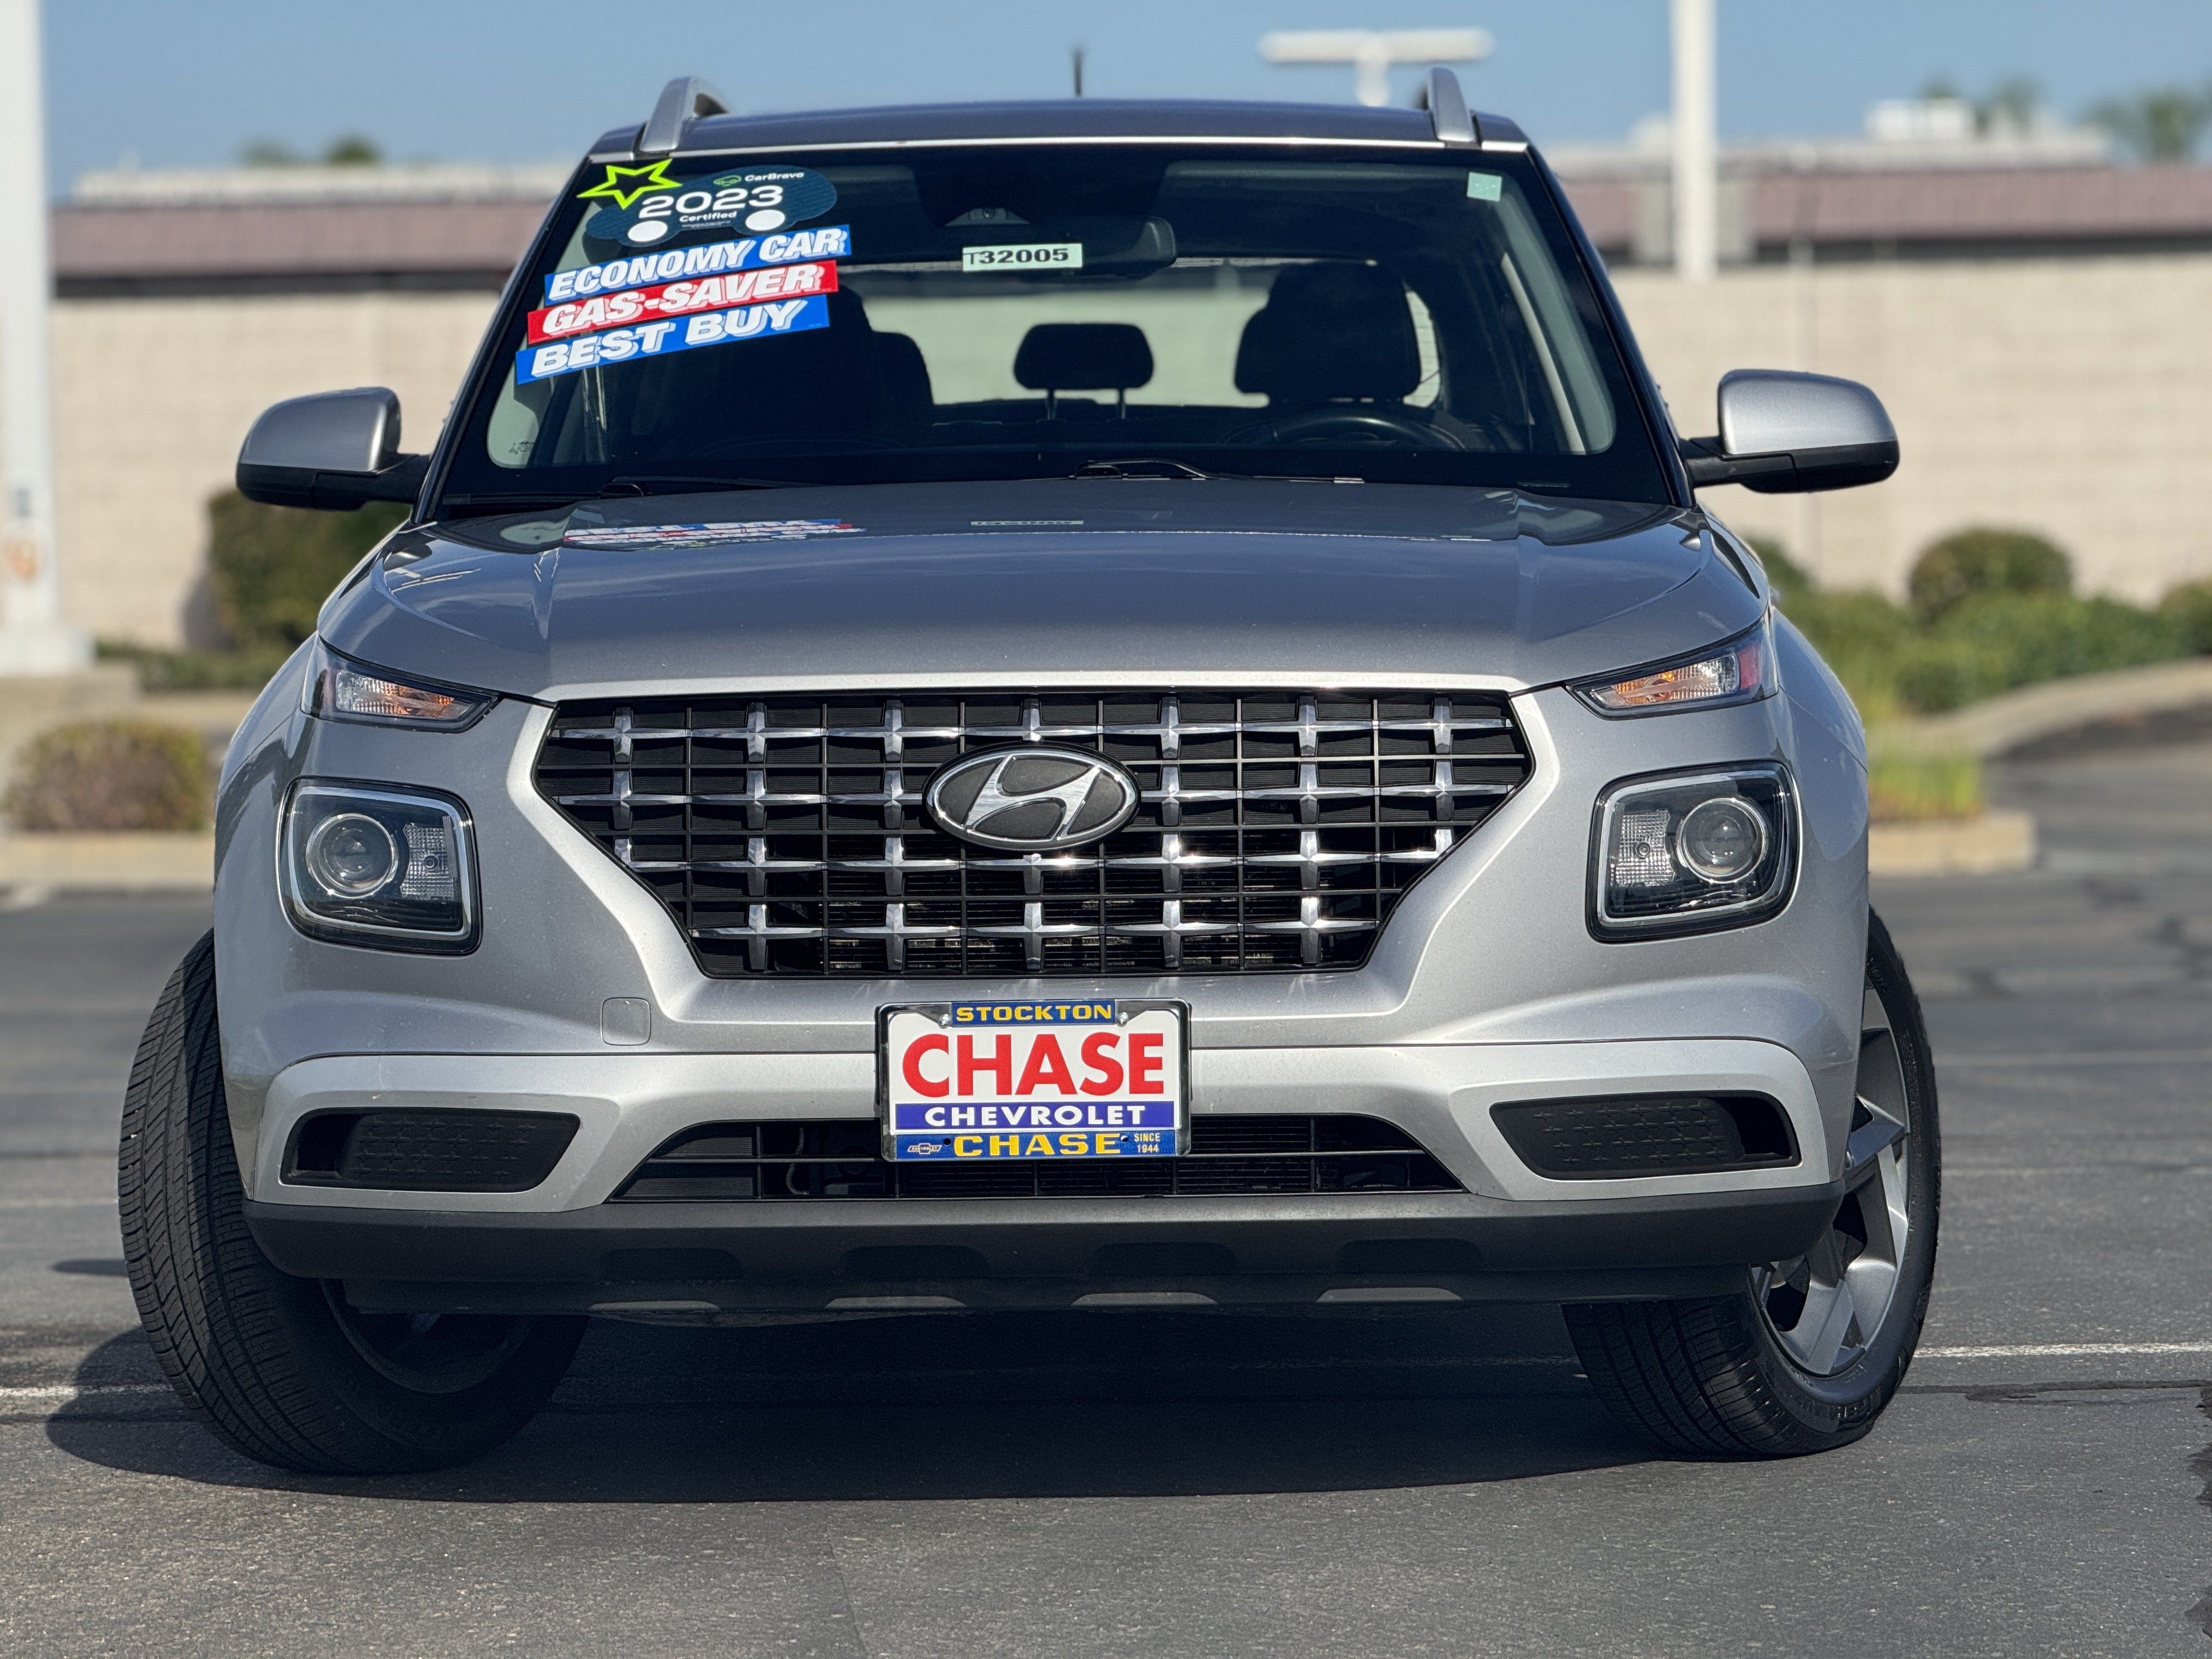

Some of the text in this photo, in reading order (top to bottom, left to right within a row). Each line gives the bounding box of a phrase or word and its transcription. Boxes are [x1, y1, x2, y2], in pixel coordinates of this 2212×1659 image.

[744, 172, 805, 182] CarBravo
[639, 185, 783, 218] 2023
[679, 211, 737, 223] Certified
[549, 228, 847, 301] ECONOMY CAR
[963, 248, 1069, 265] T32005
[542, 263, 825, 336] GAS-SAVER
[531, 300, 808, 378] BEST BUY
[956, 1005, 1111, 1022] STOCKTON
[902, 1032, 1164, 1097] CHASE
[925, 1105, 1146, 1126] CHEVROLET
[954, 1133, 1121, 1157] CHASE
[1134, 1132, 1160, 1142] SINCE
[1137, 1144, 1159, 1153] 1944
